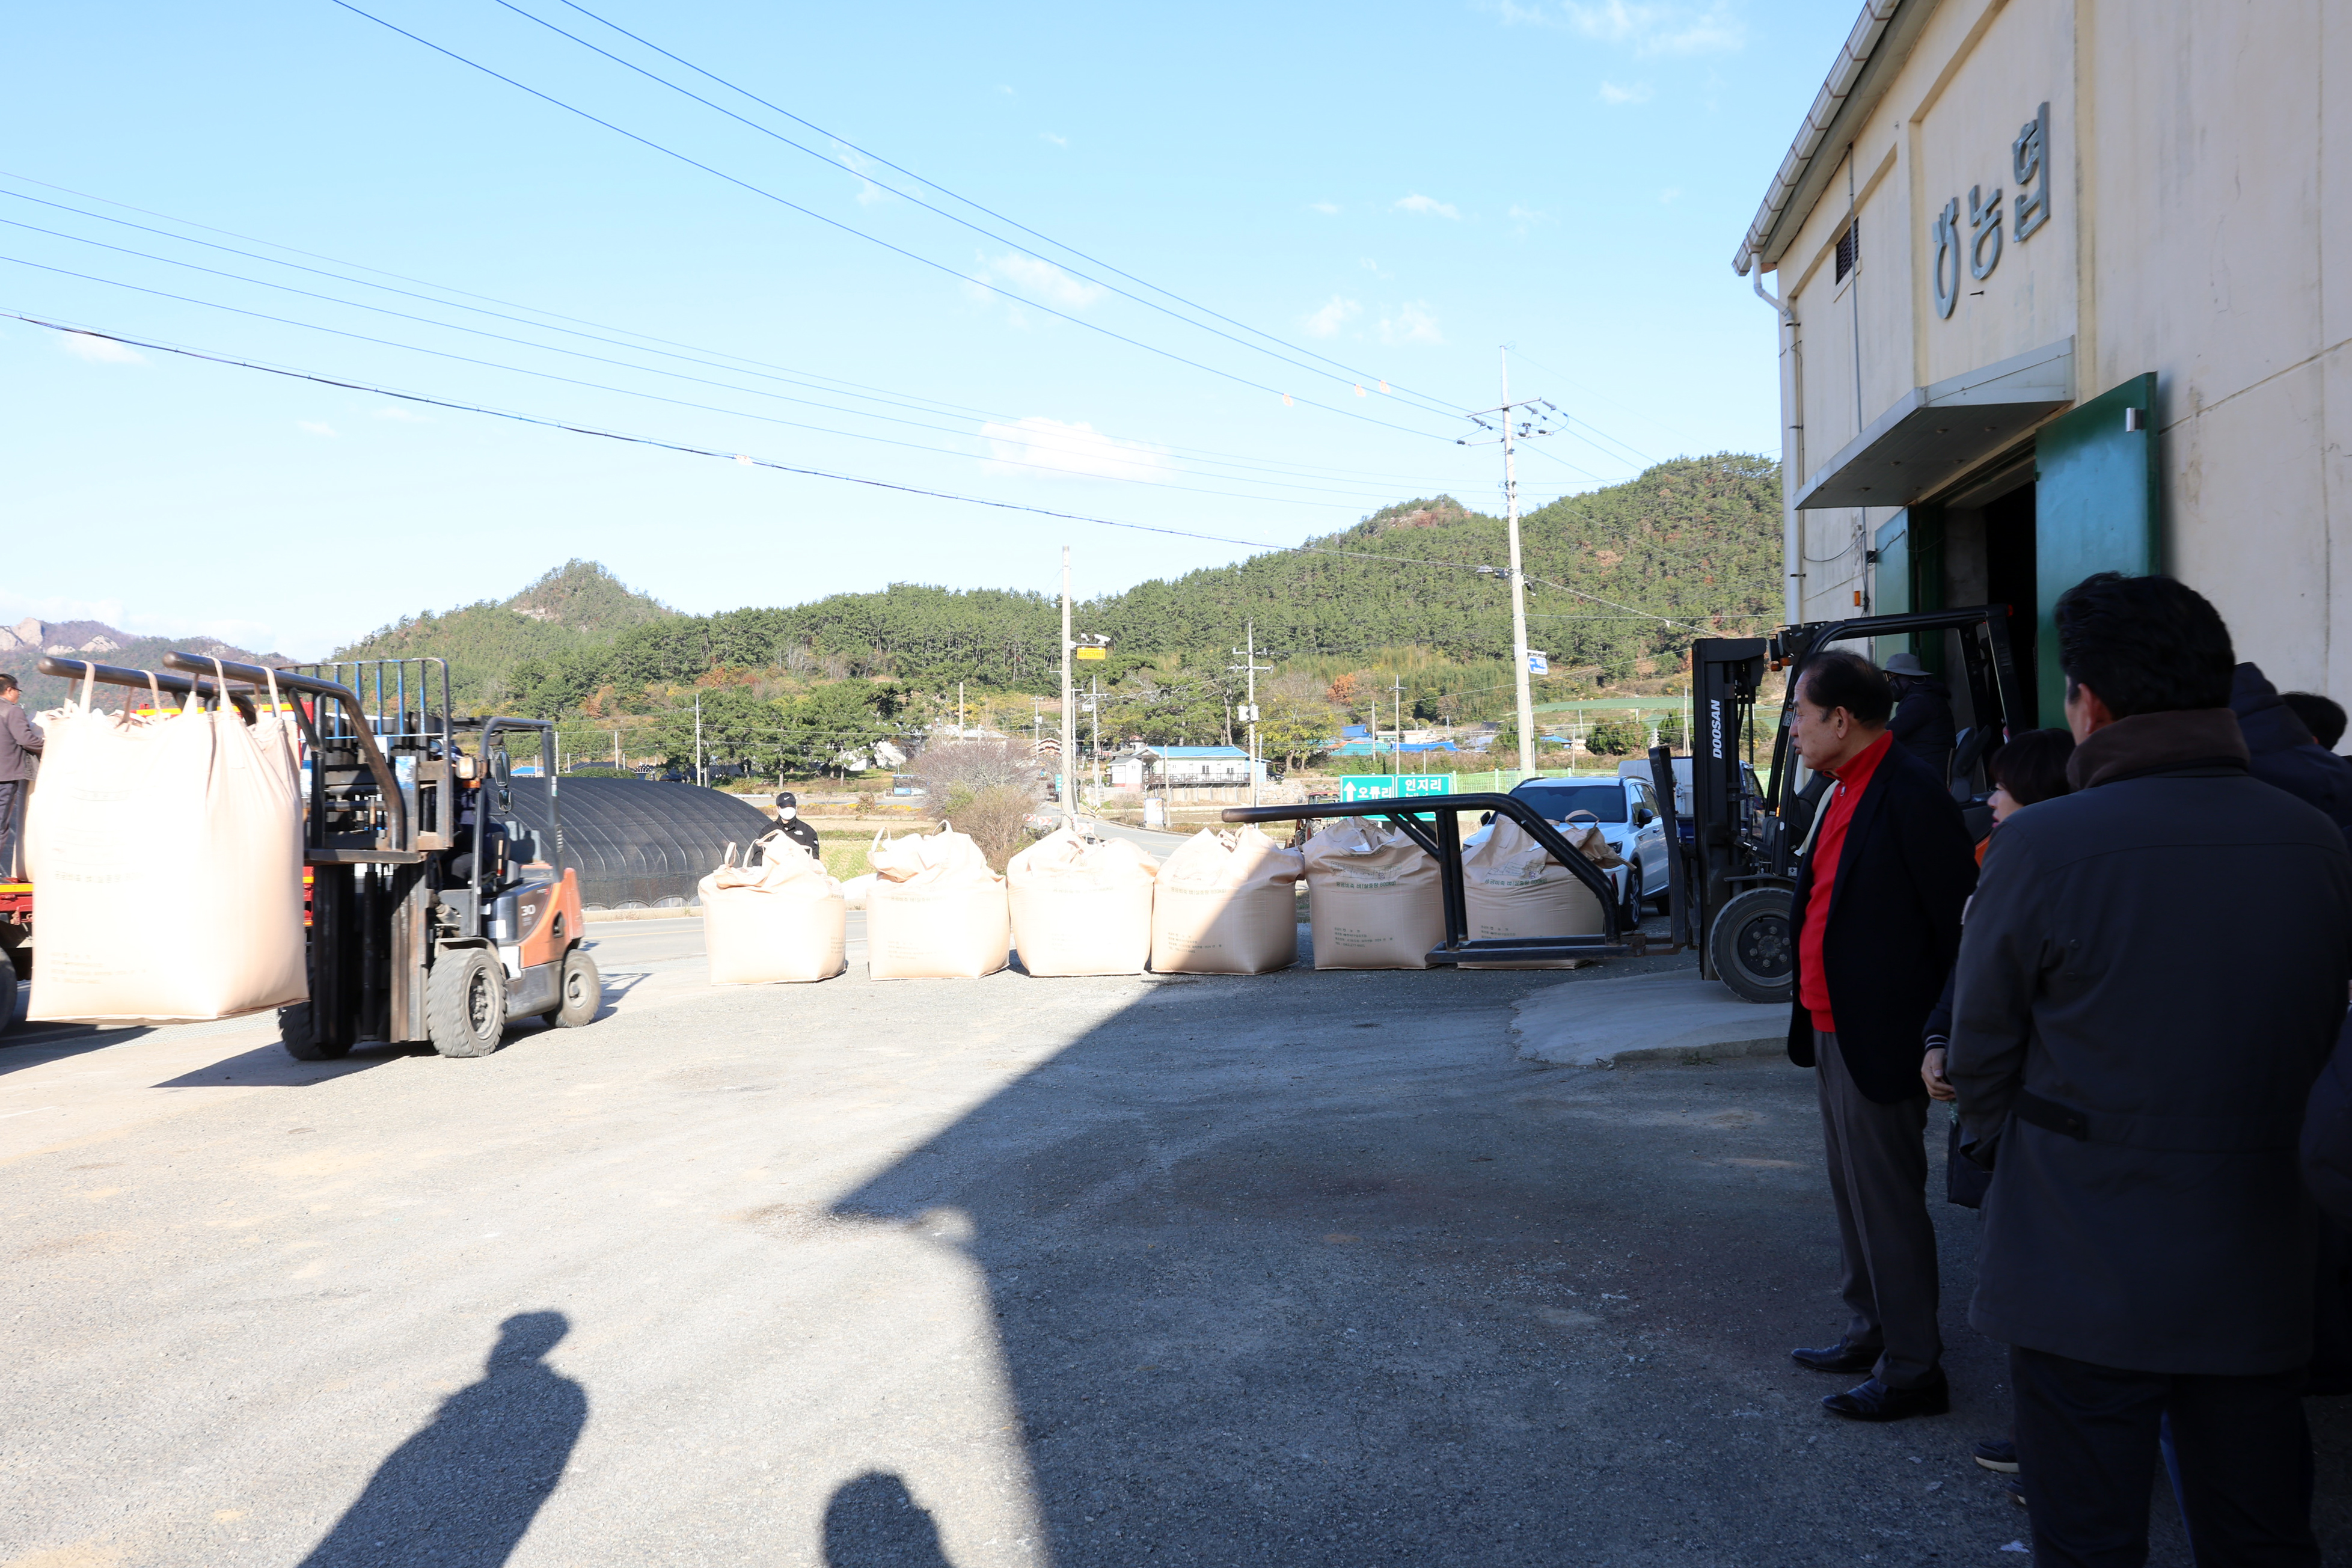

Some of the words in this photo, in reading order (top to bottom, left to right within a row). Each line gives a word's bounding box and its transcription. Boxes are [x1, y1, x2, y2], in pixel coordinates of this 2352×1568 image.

[1710, 699, 1722, 759] DOOSAN
[1405, 779, 1442, 792] 인지리
[1357, 786, 1392, 799] 오류리
[521, 904, 536, 916] 30
